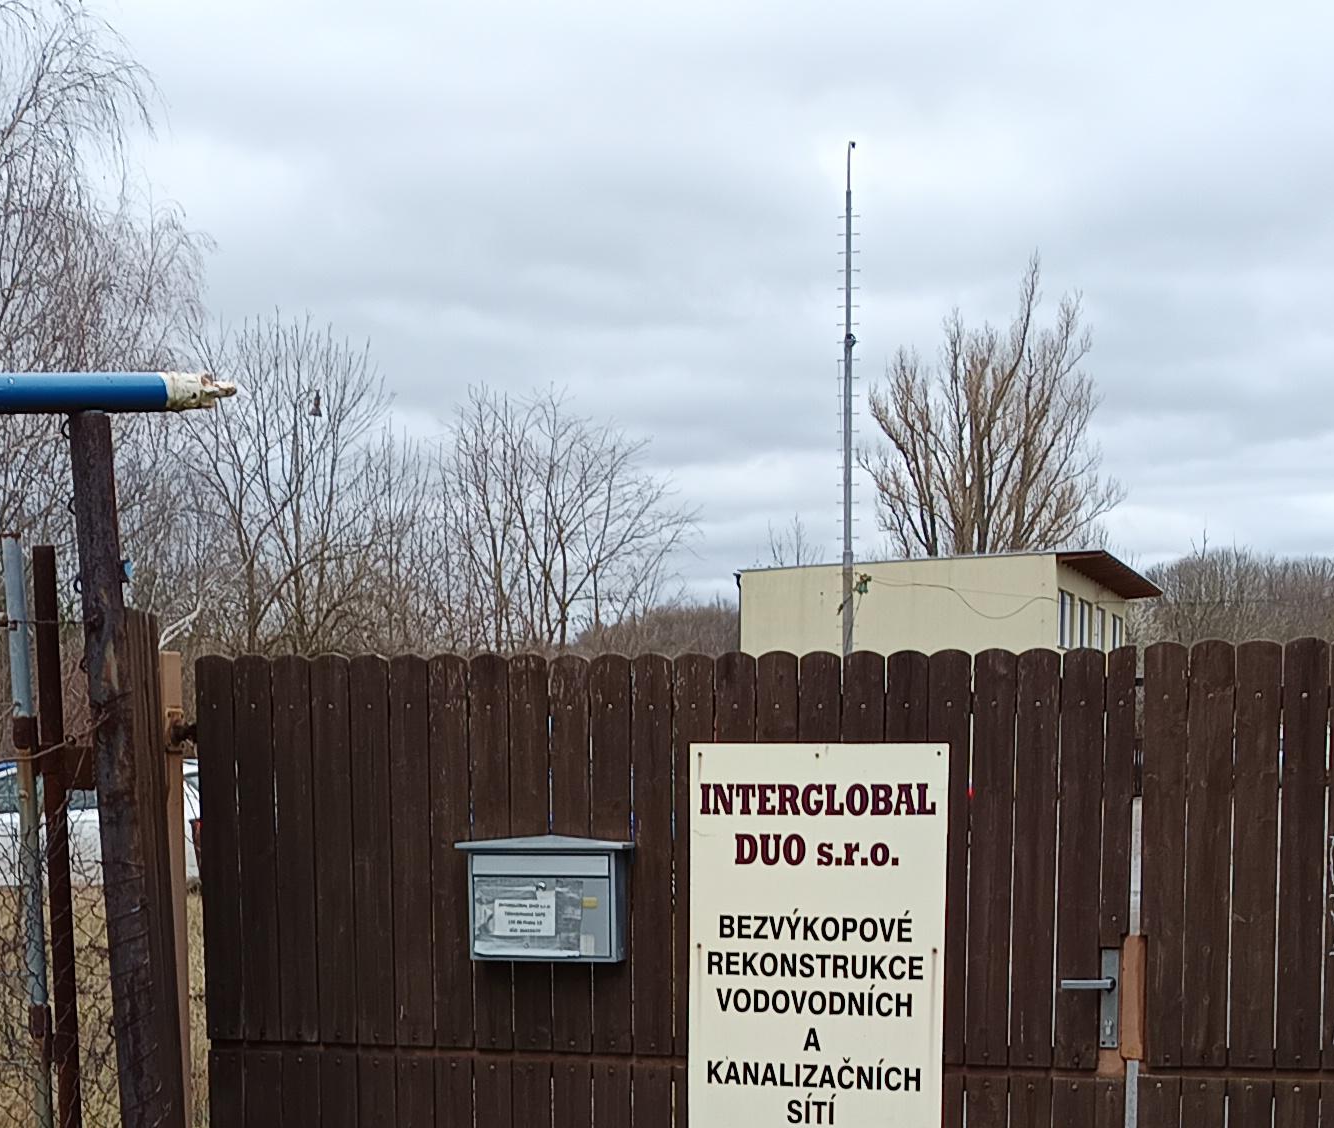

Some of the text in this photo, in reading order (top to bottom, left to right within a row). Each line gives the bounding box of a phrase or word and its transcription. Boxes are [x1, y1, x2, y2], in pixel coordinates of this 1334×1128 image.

[699, 783, 936, 816] INTERGLOBAL
[734, 833, 900, 866] DUO s.r.o.
[719, 909, 913, 944] BEZVÝKOPOVÉ
[707, 951, 924, 981] REKONSTRUKCE
[716, 985, 913, 1018] VODOVODNÍCH
[803, 1027, 821, 1052] A
[706, 1057, 921, 1092] KANALIZAČNÍCH
[786, 1093, 837, 1125] SÍTÍ
